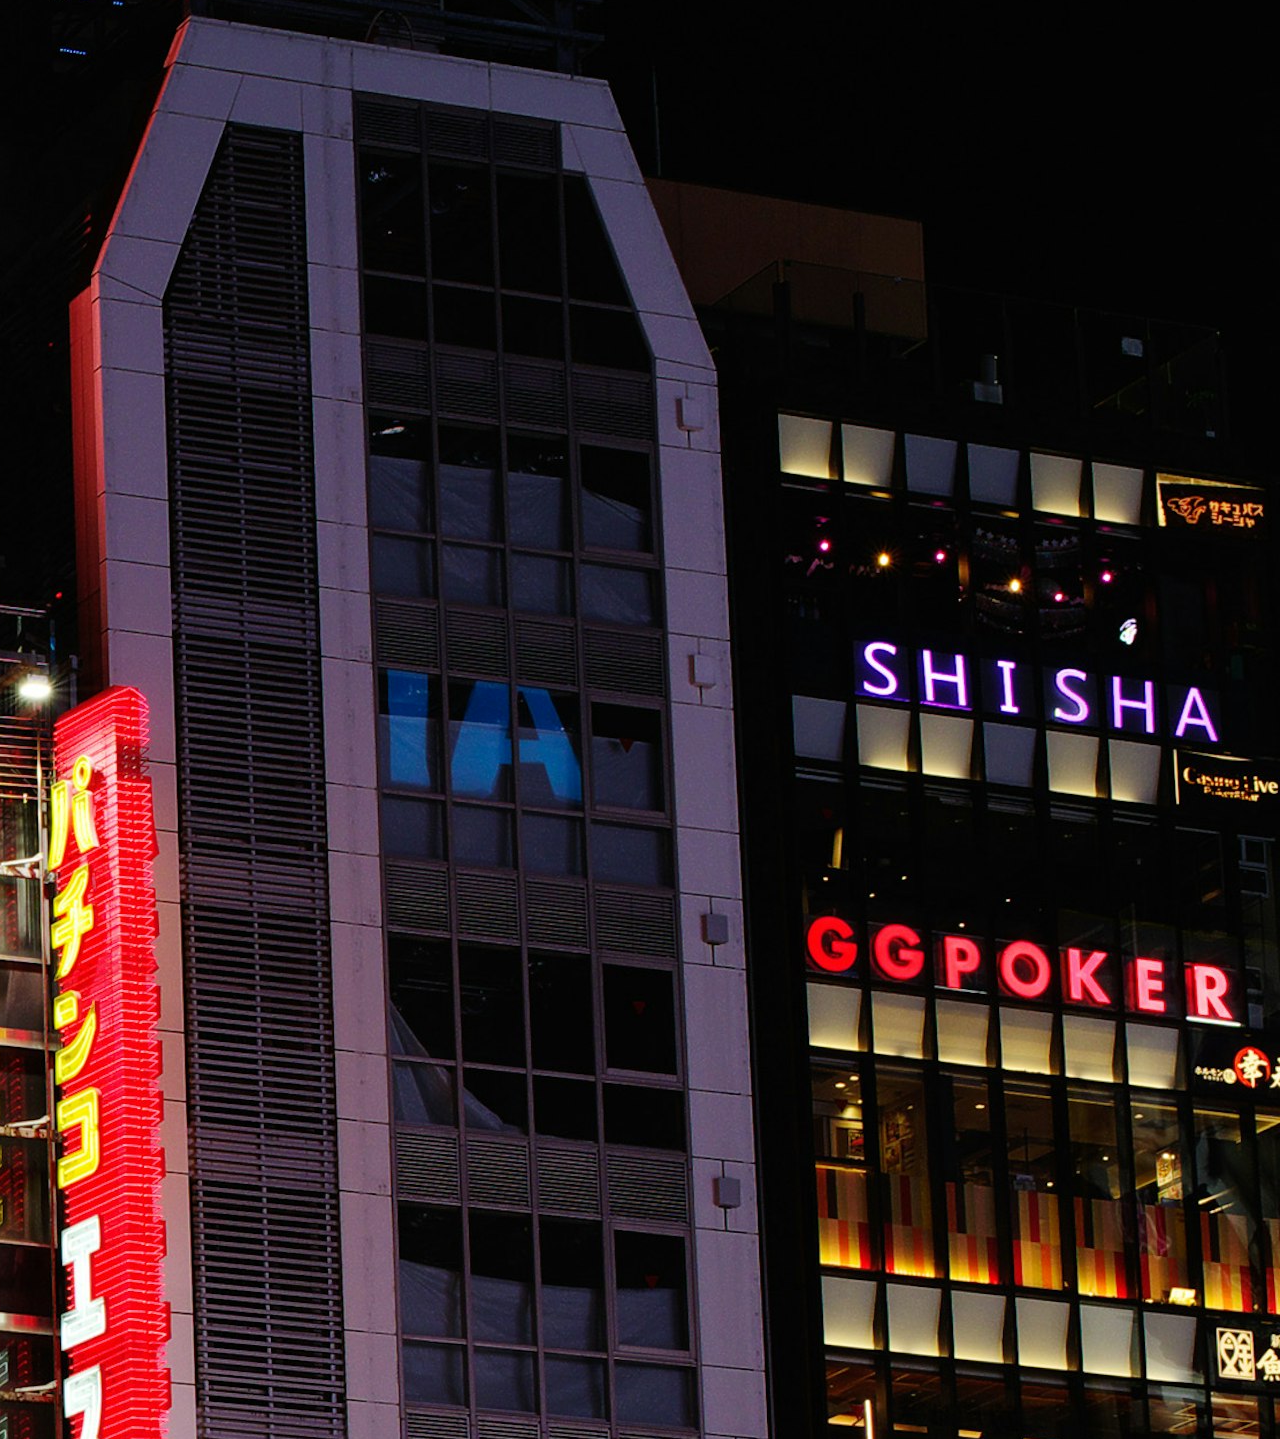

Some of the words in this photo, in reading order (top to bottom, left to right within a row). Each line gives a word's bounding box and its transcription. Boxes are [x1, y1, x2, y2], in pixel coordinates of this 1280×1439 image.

[862, 642, 1220, 743] SHISHA
[48, 752, 101, 1192] パチンコ
[807, 915, 1234, 1021] GGPOKER
